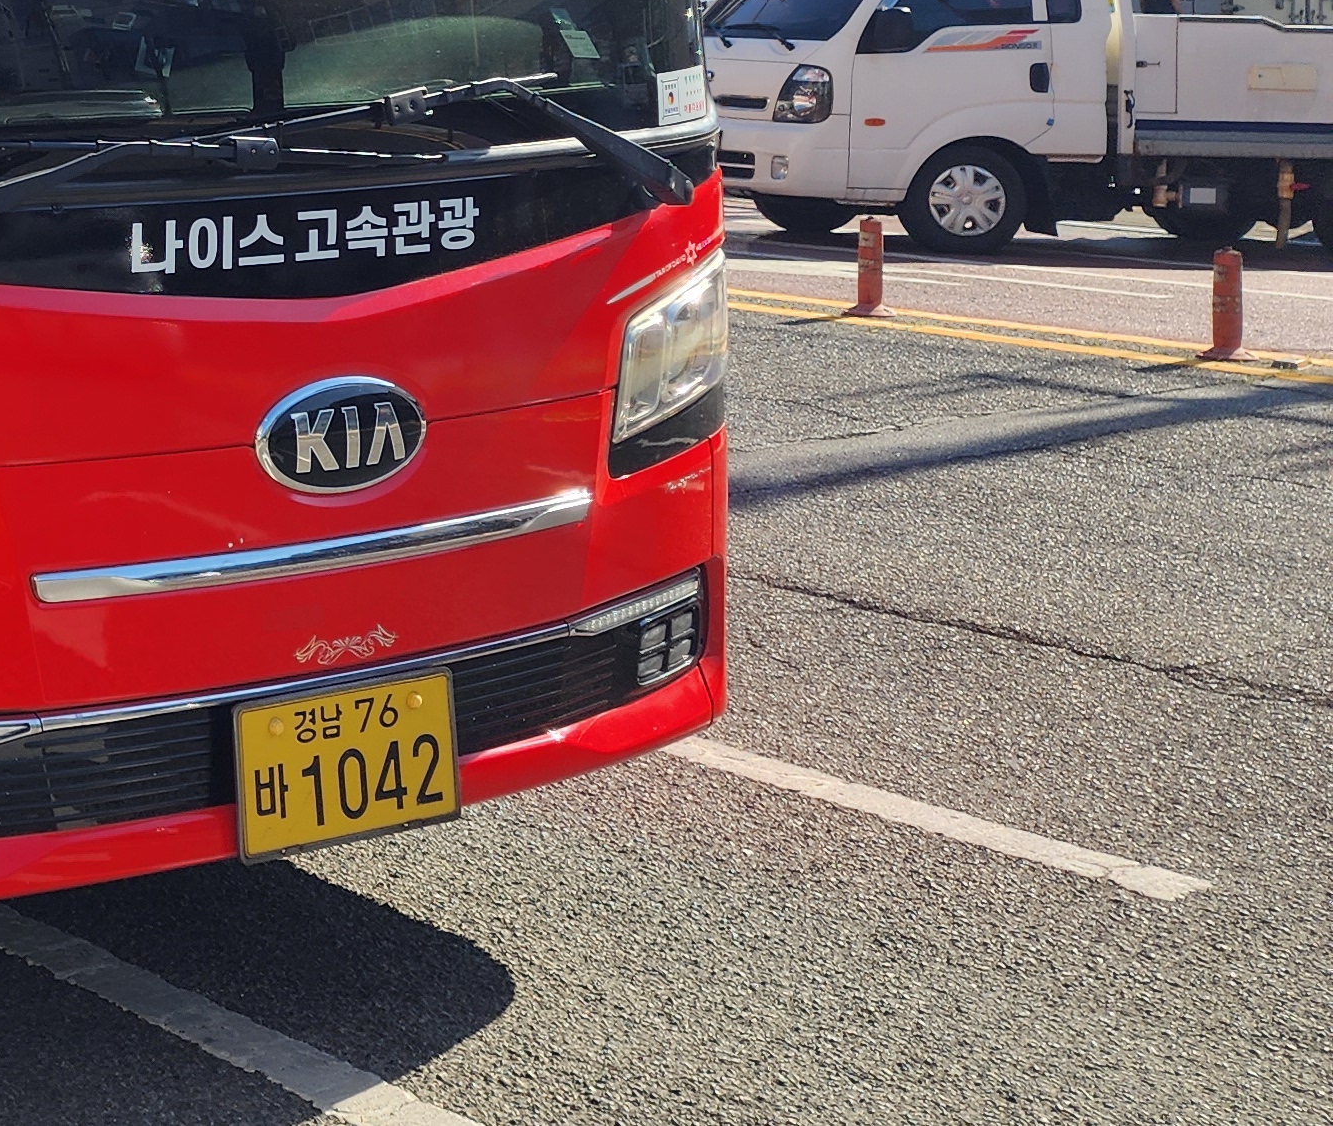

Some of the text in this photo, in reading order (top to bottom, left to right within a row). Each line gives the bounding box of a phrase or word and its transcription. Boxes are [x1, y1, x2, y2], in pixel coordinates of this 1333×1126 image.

[291, 401, 406, 474] KIA
[294, 693, 400, 743] 경남 76
[254, 733, 444, 827] 바 1042
